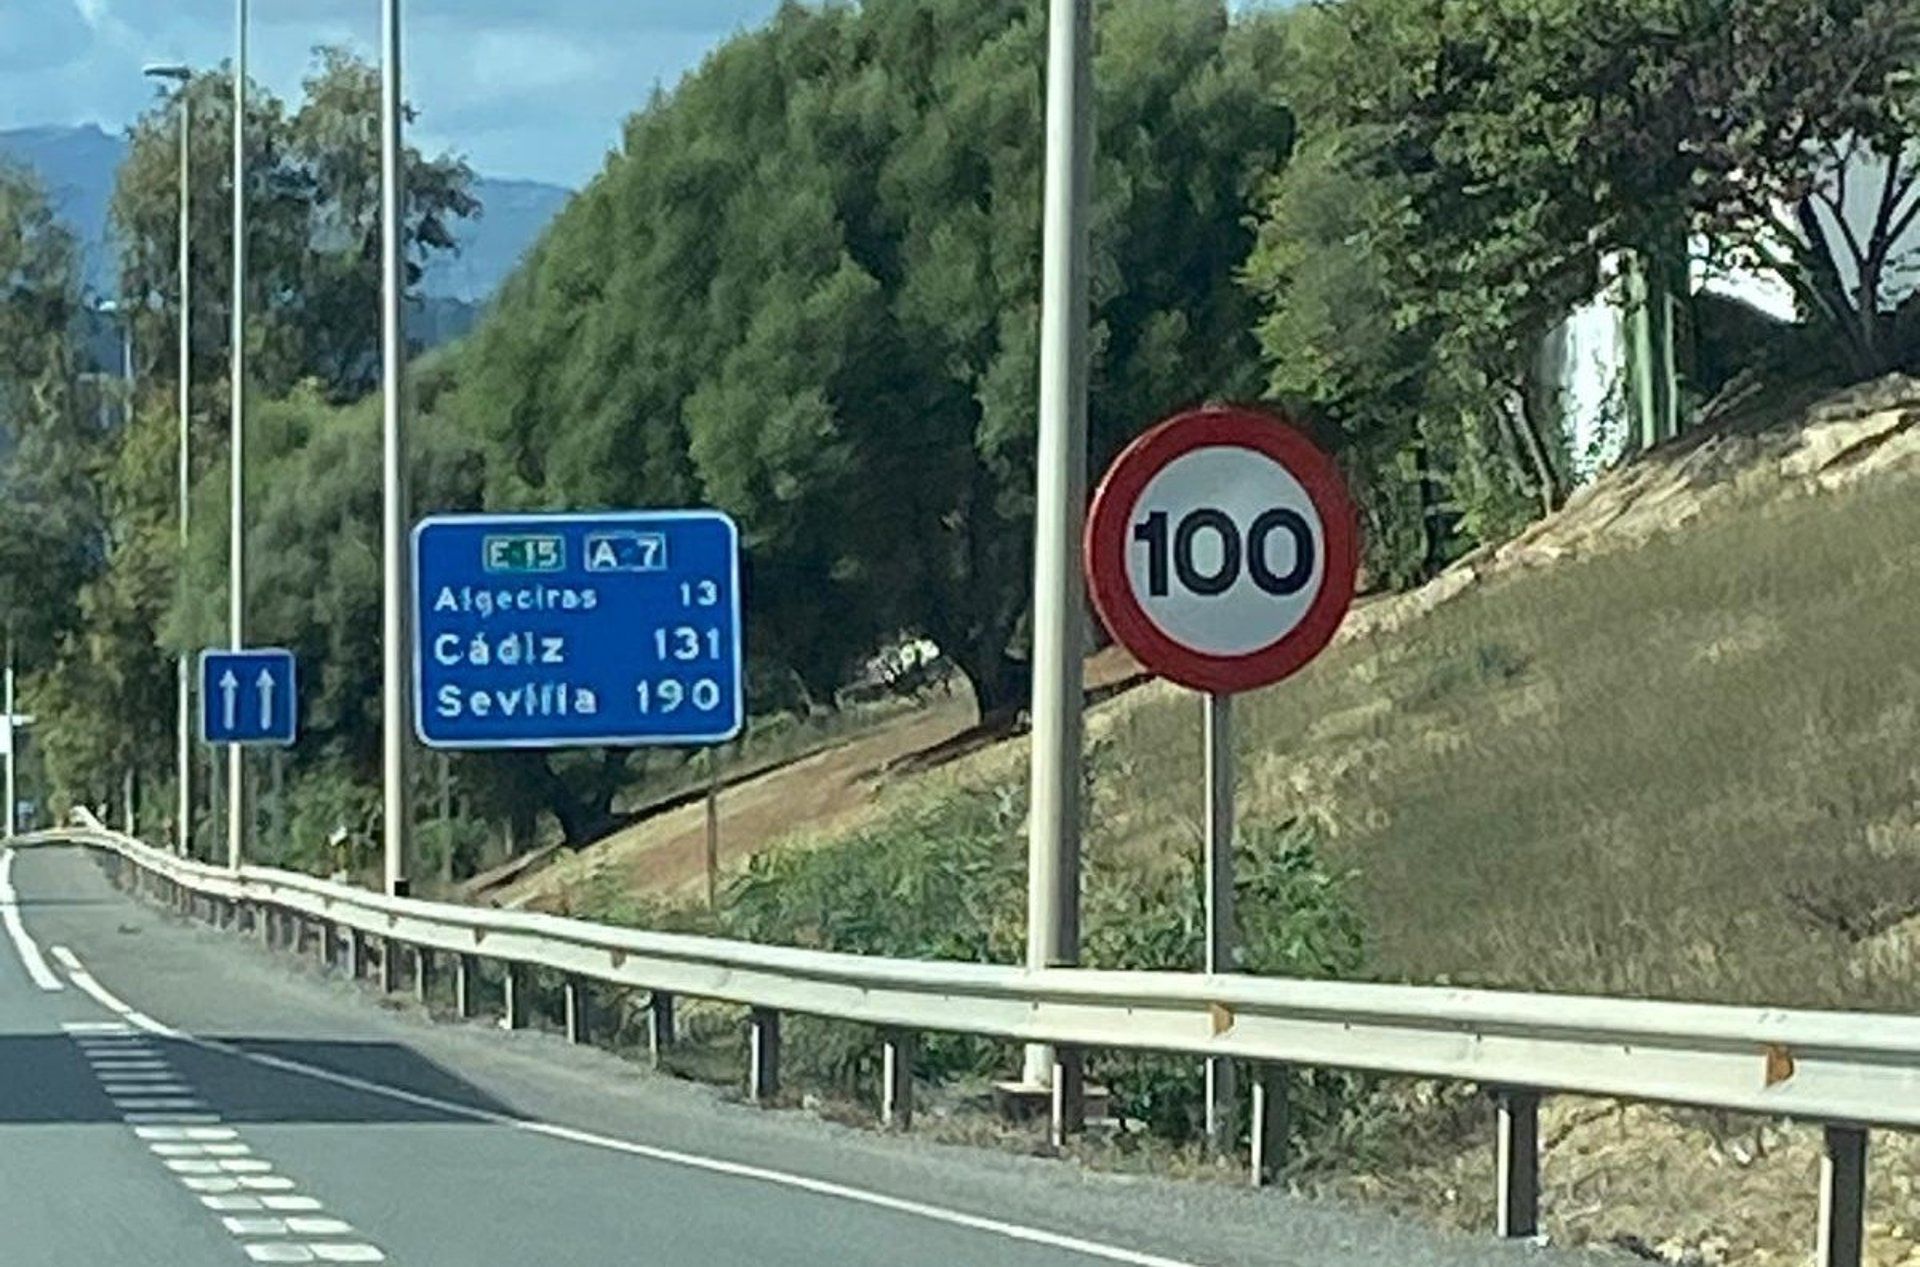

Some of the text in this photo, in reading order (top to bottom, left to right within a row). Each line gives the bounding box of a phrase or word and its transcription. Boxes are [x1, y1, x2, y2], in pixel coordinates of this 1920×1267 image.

[1134, 508, 1316, 597] 100
[434, 580, 718, 618] Algeciras 13
[434, 626, 721, 666] Cádiz 131
[437, 678, 721, 717] Sevilla 190
